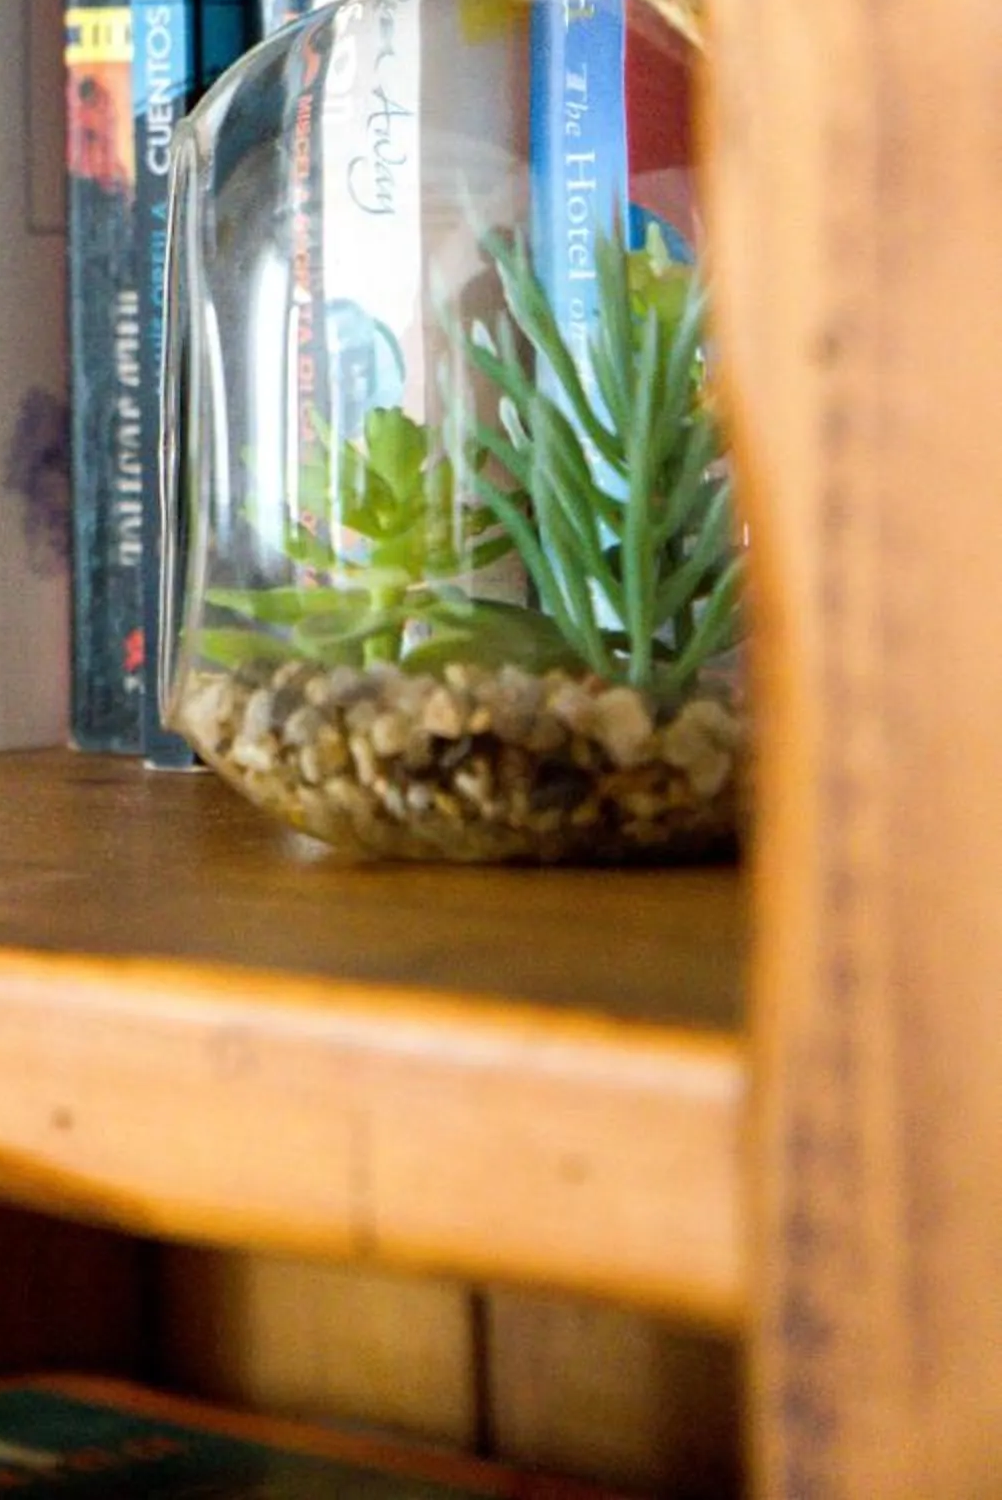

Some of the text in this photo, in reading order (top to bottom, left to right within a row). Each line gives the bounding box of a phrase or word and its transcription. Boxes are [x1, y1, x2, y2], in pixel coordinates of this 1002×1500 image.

[145, 4, 175, 177] CUENTOS
[347, 84, 415, 215] Away
[560, 67, 589, 138] The
[564, 151, 597, 282] Hotel
